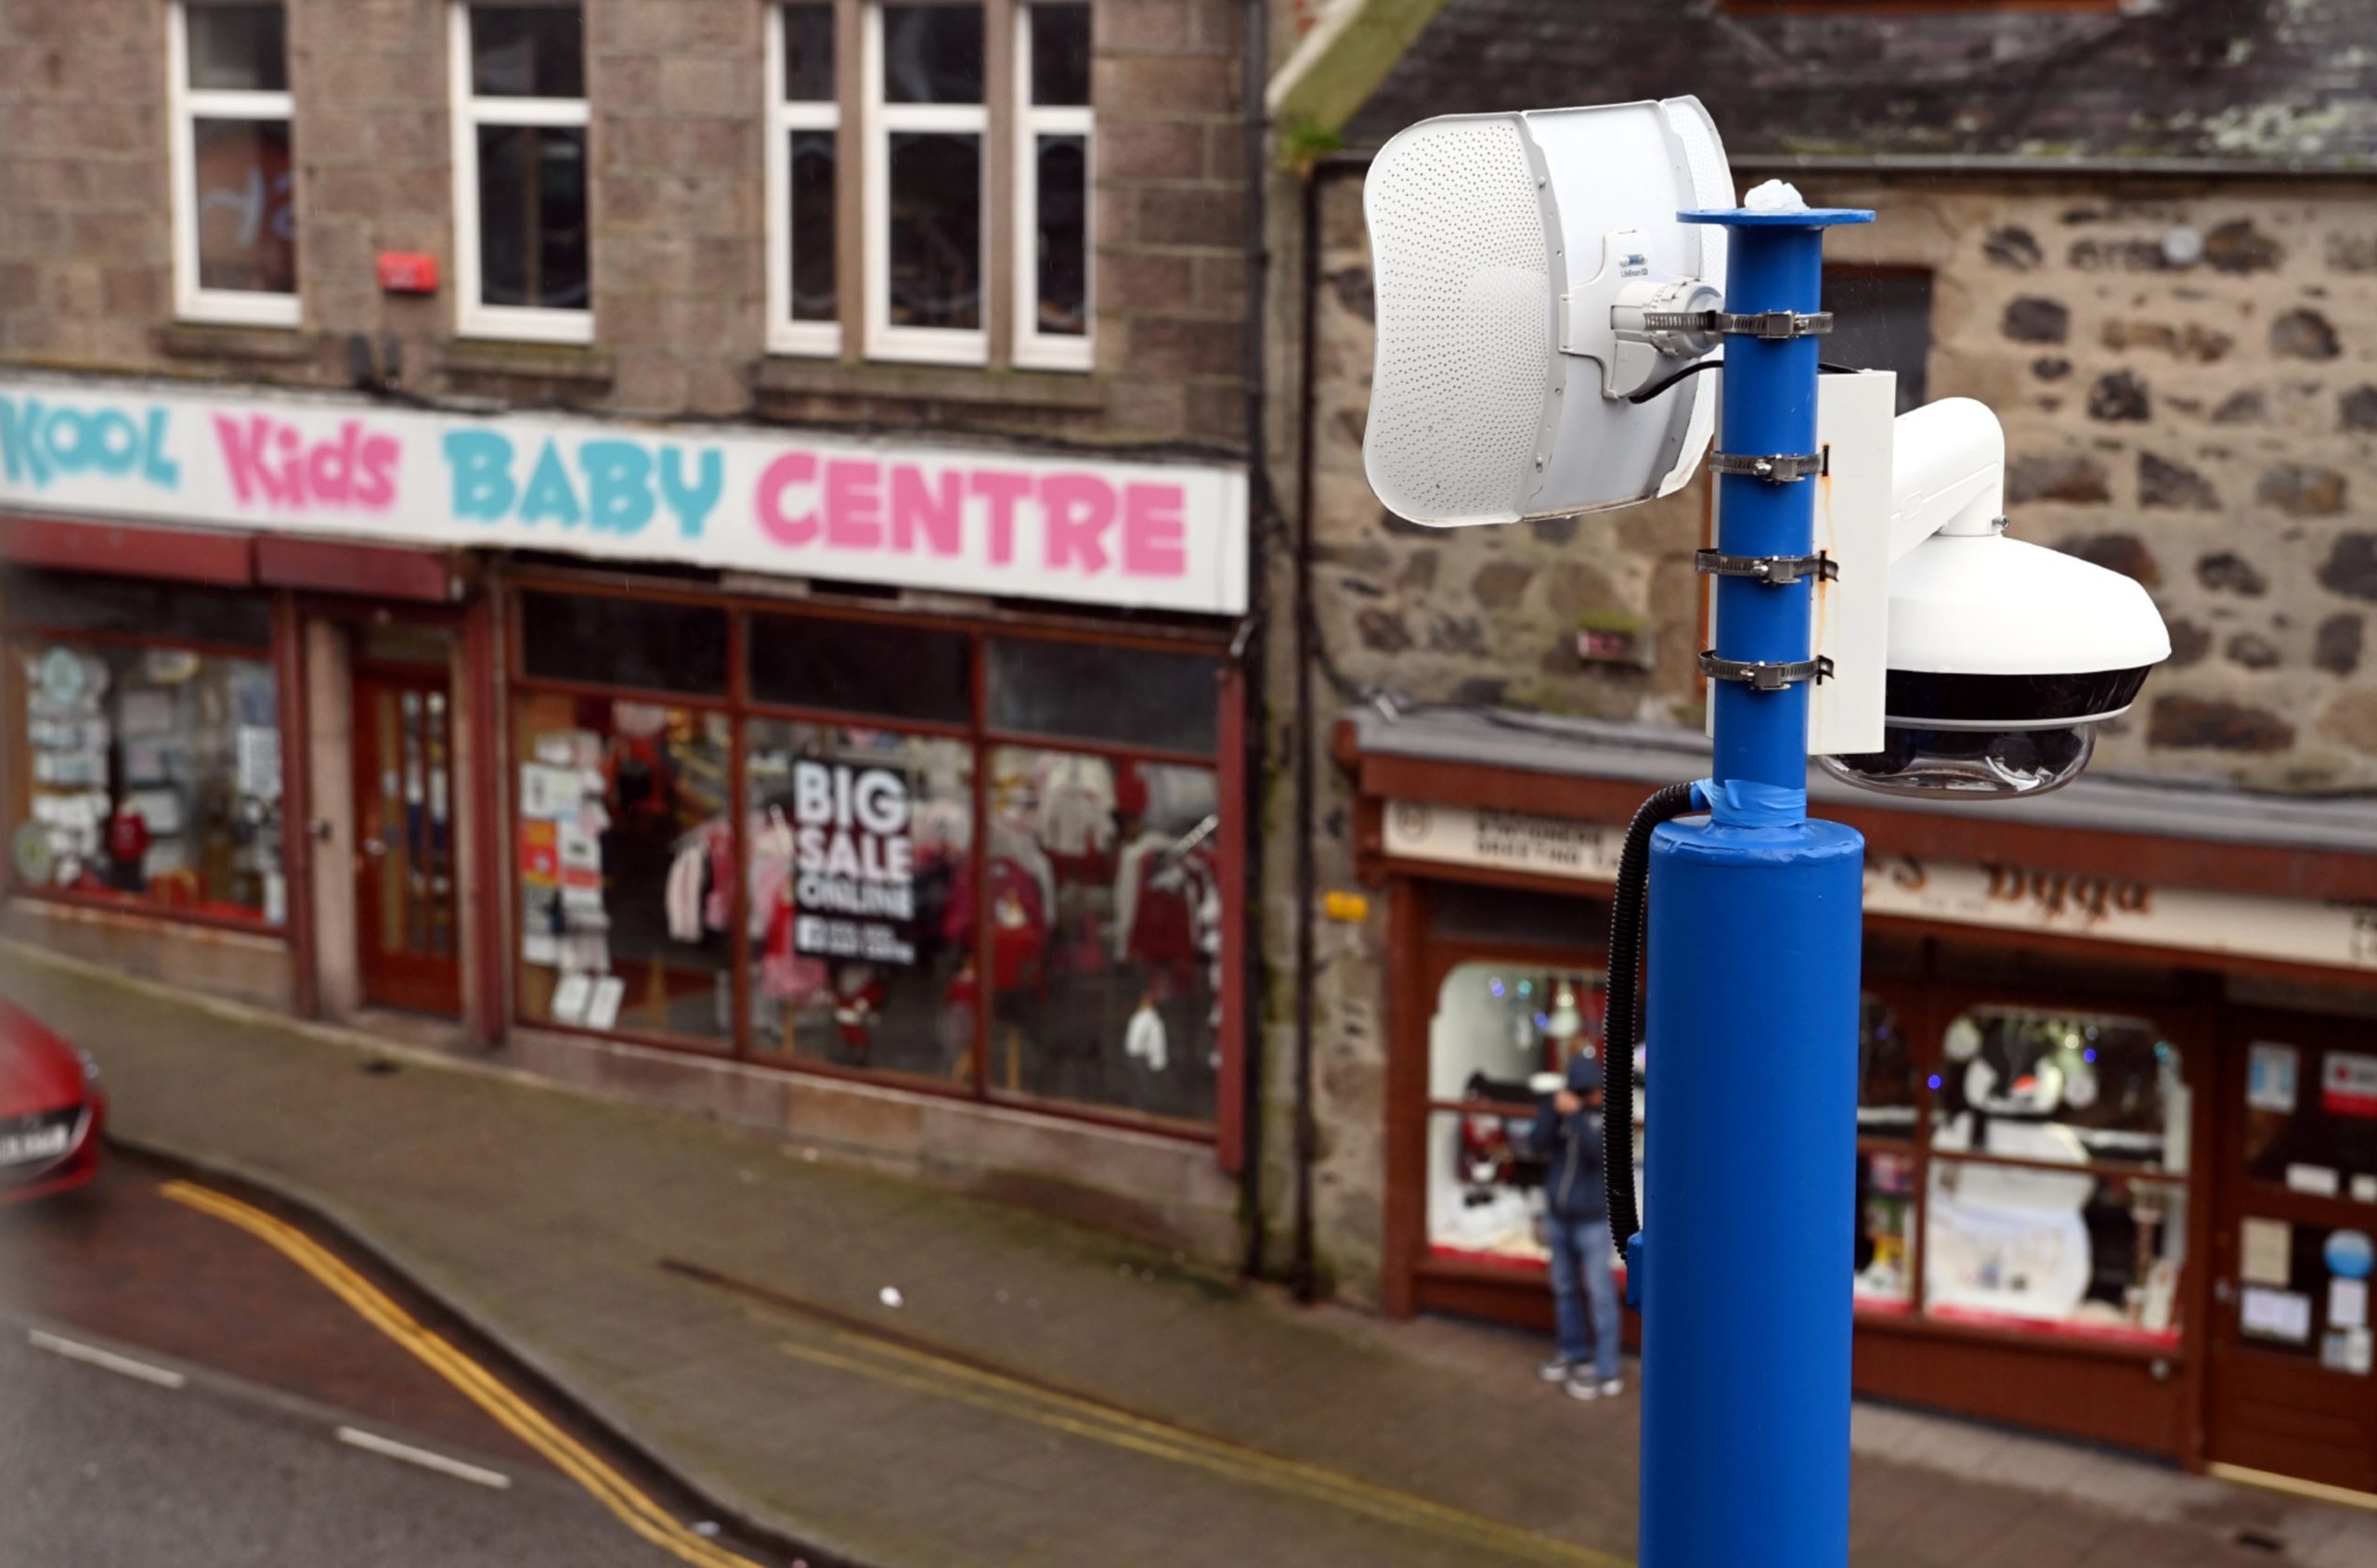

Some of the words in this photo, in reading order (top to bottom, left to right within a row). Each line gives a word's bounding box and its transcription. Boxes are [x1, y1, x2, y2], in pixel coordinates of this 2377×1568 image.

[0, 395, 180, 490] KOOL
[213, 412, 402, 513] Kids
[441, 427, 724, 538] BABY
[753, 449, 1188, 578] CENTRE
[794, 760, 908, 835] BIG
[798, 827, 913, 882] SALE
